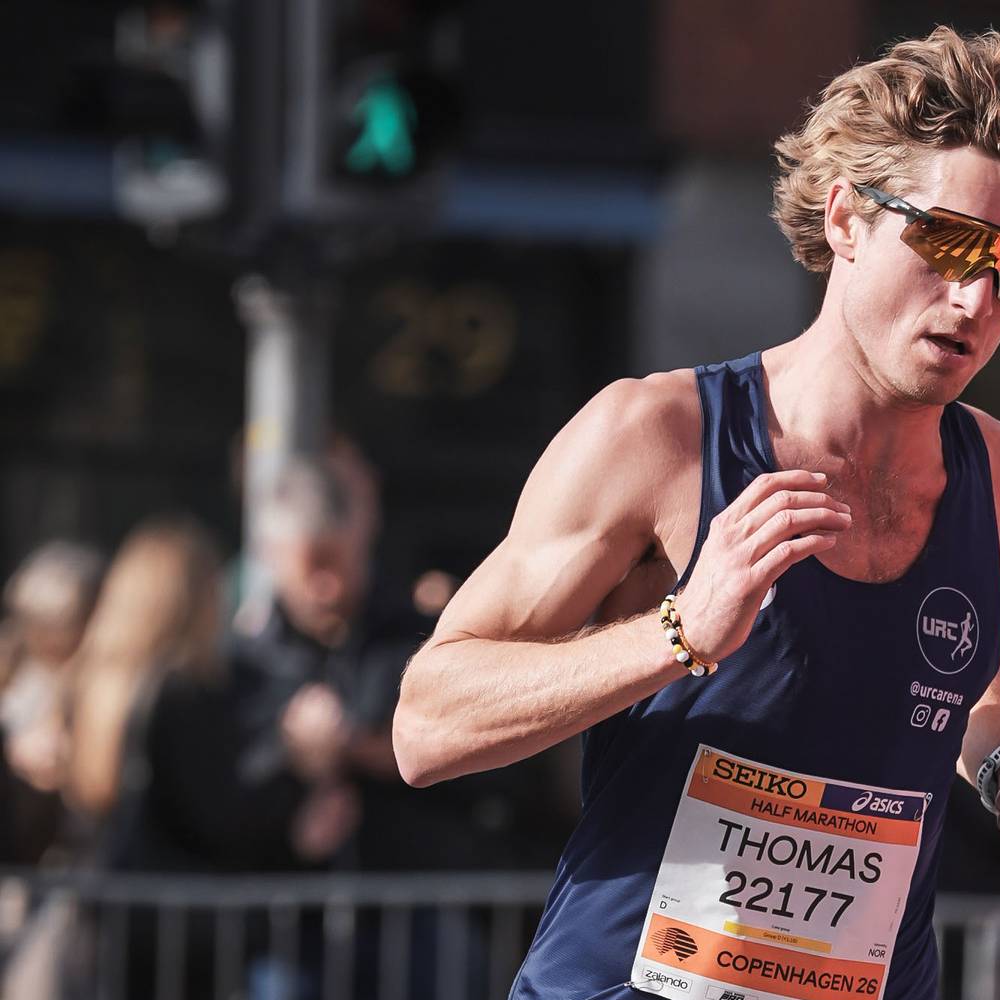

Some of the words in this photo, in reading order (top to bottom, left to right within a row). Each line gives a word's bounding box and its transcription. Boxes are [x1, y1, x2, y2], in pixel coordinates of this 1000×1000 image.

[922, 616, 958, 641] URC
[911, 681, 963, 706] @urcarena
[713, 758, 807, 799] SEIKO
[751, 798, 793, 818] HALF
[794, 810, 878, 835] MARATHON
[870, 797, 904, 815] asics
[718, 818, 883, 883] THOMAS
[660, 901, 667, 909] D
[719, 871, 855, 927] 22177
[868, 949, 886, 958] NOR
[645, 969, 688, 990] zalando
[717, 951, 853, 992] COPENHAGEN
[856, 977, 878, 995] 26
